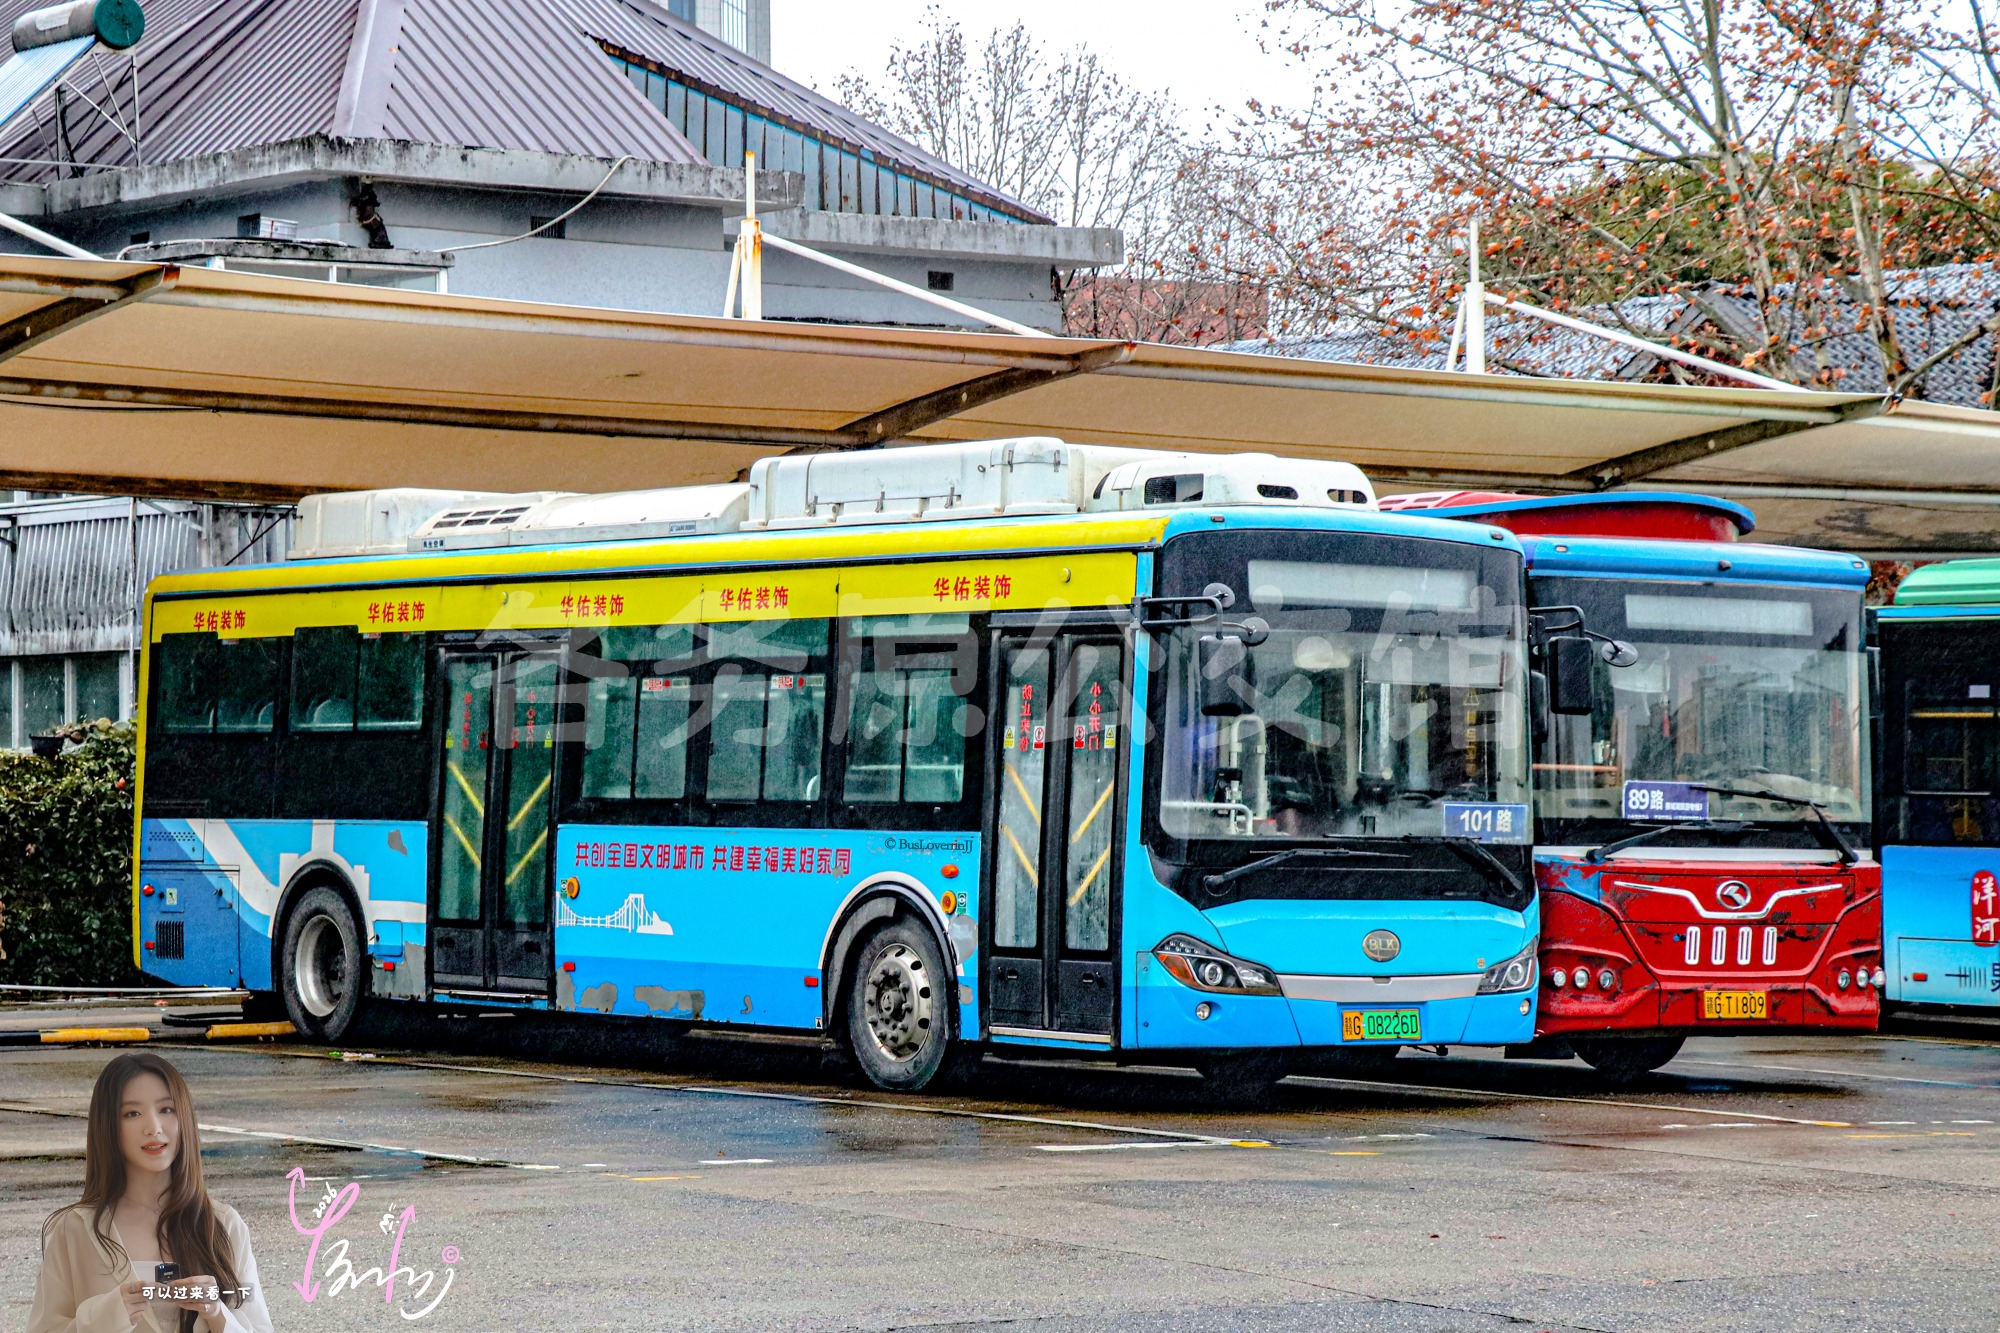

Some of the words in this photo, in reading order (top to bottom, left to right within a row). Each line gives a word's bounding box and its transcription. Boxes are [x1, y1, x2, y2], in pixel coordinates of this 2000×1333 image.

[720, 586, 790, 611] 华佑装饰
[933, 574, 1012, 602] 华佑装饰
[368, 602, 425, 623] 华佑装饰
[560, 594, 625, 617] 华佑装饰
[193, 610, 246, 631] 华佑装饰
[1628, 789, 1664, 810] 89路
[1460, 809, 1512, 832] 101路
[575, 842, 704, 869] 共创全国文明城市
[712, 845, 851, 875] 共建幸福美好家园
[1973, 876, 2000, 942] 洋河
[1369, 938, 1397, 950] BLK
